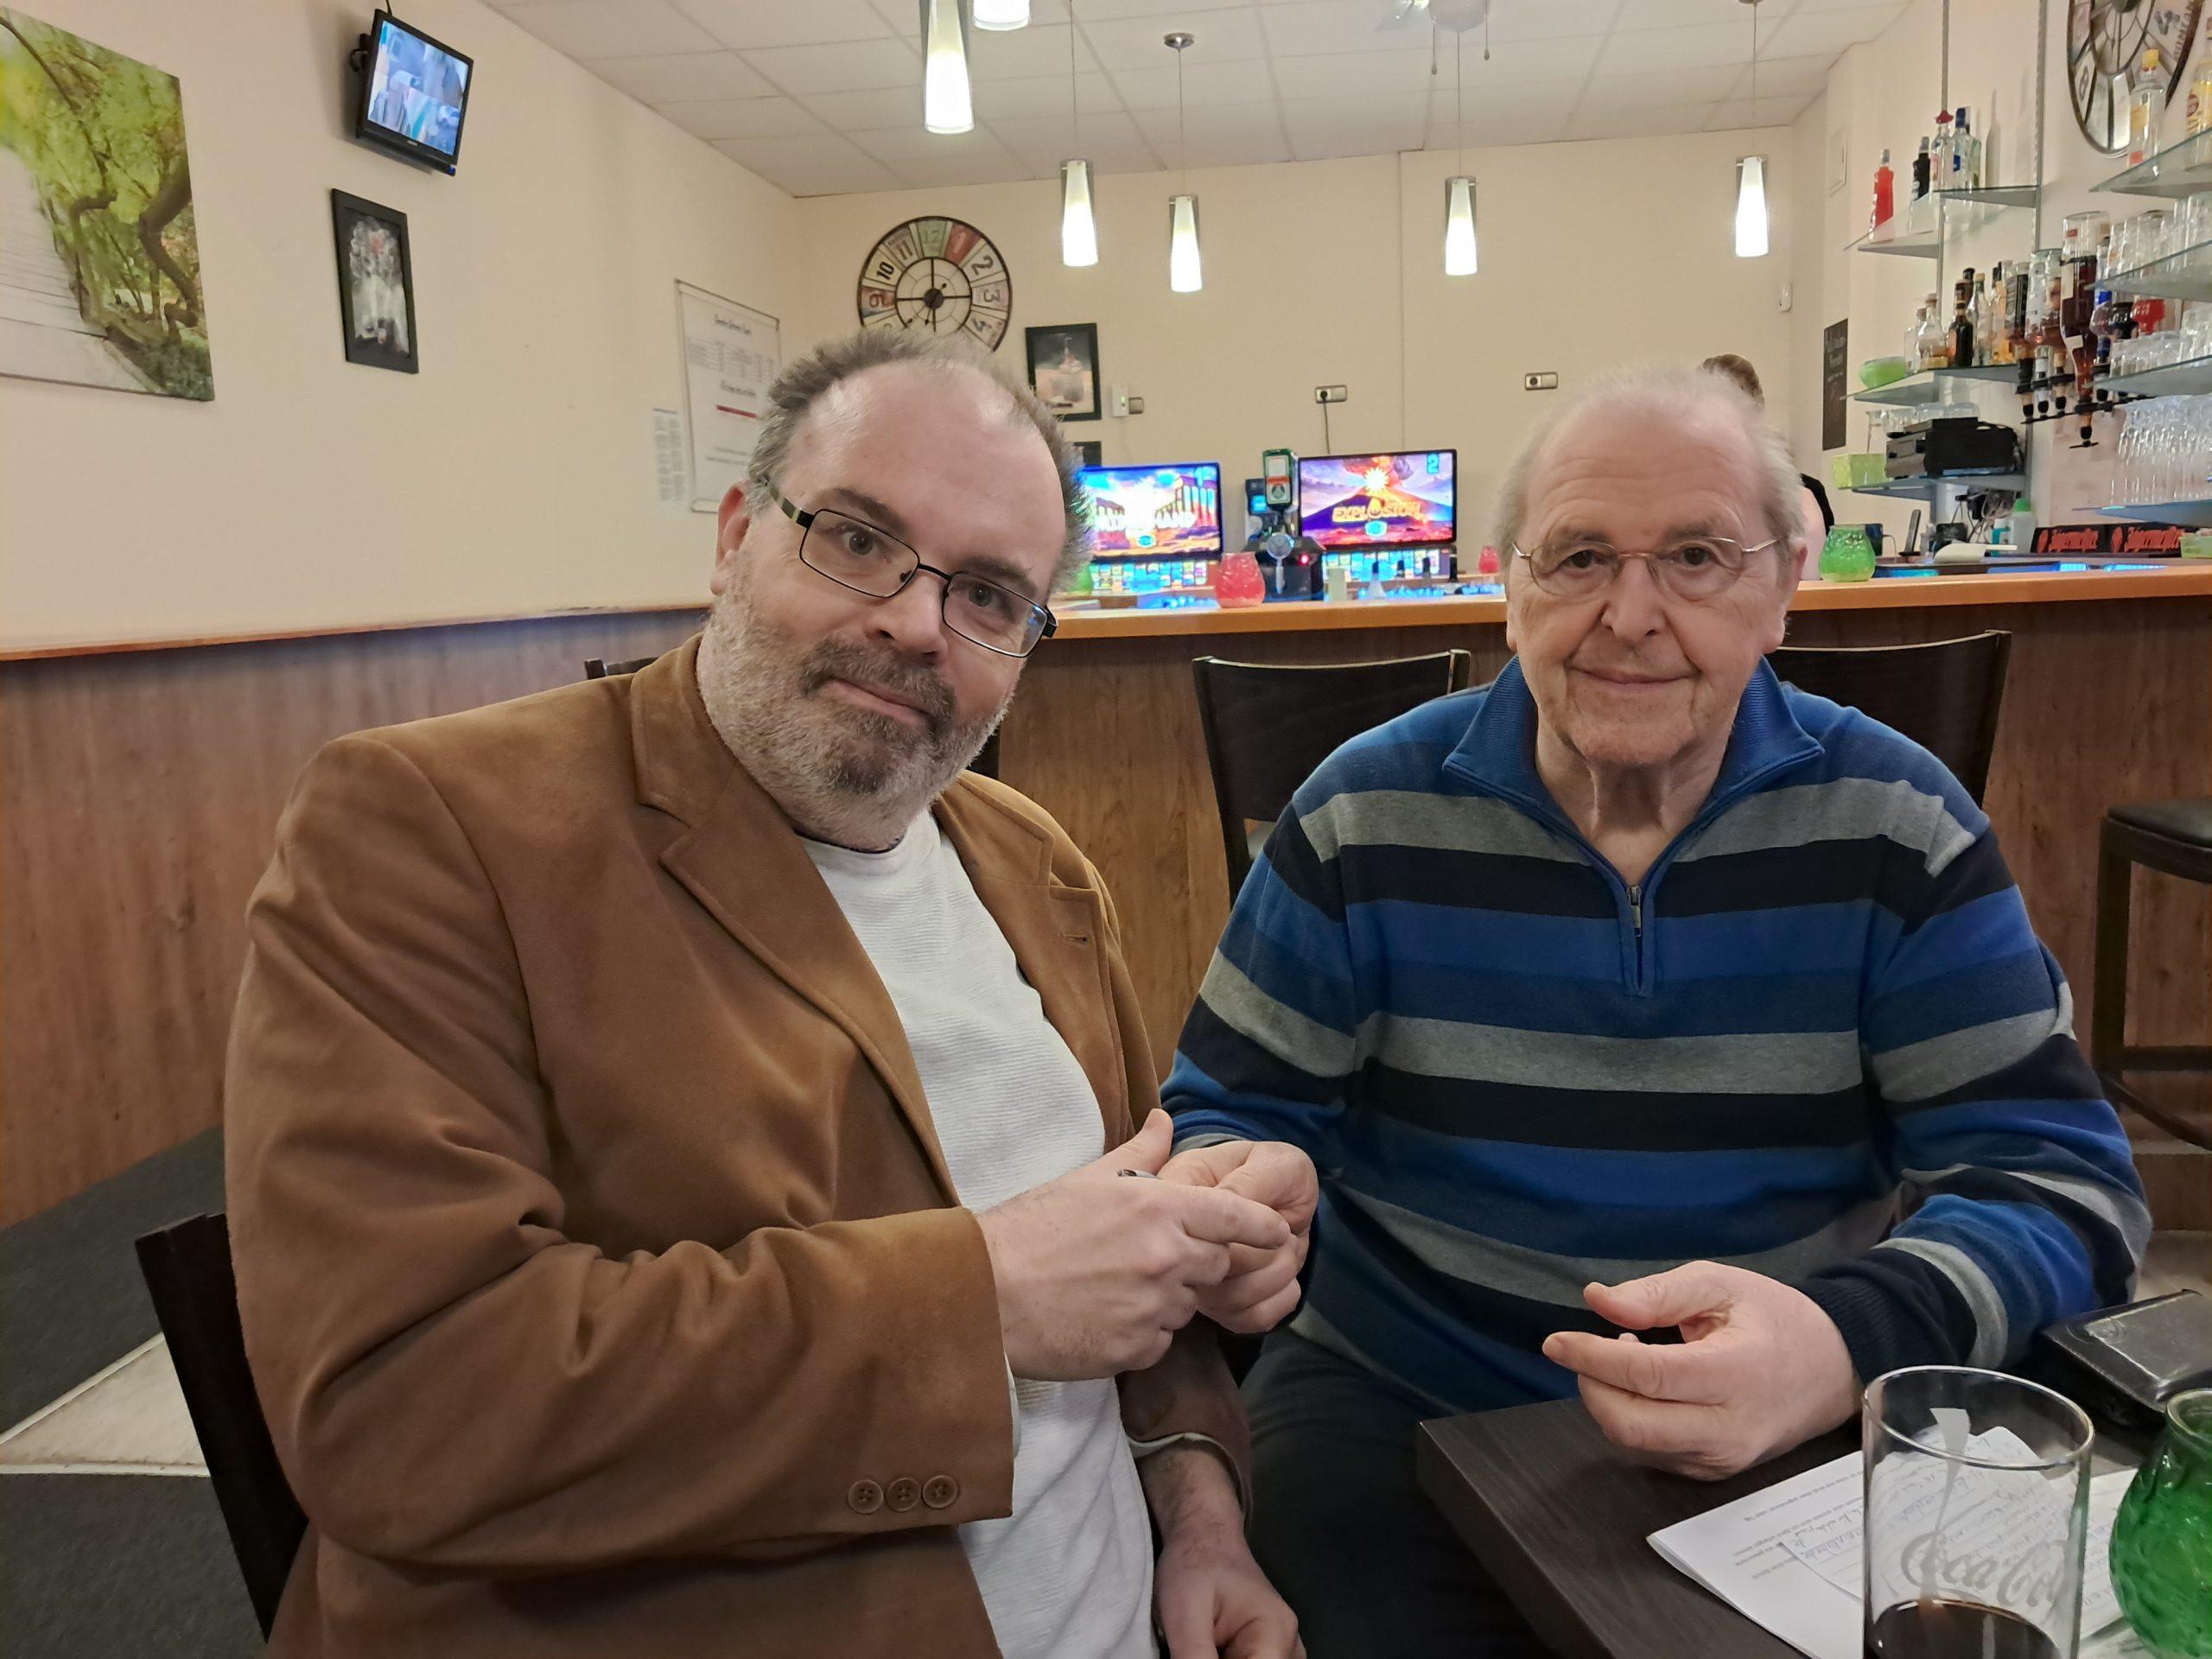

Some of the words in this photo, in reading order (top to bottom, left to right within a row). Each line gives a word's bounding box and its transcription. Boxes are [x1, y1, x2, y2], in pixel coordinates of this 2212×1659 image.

[922, 229, 941, 245] 12
[896, 240, 912, 260] 11
[876, 261, 894, 280] 10
[970, 255, 994, 276] 2
[983, 289, 1001, 302] 3
[1427, 454, 1440, 474] 2
